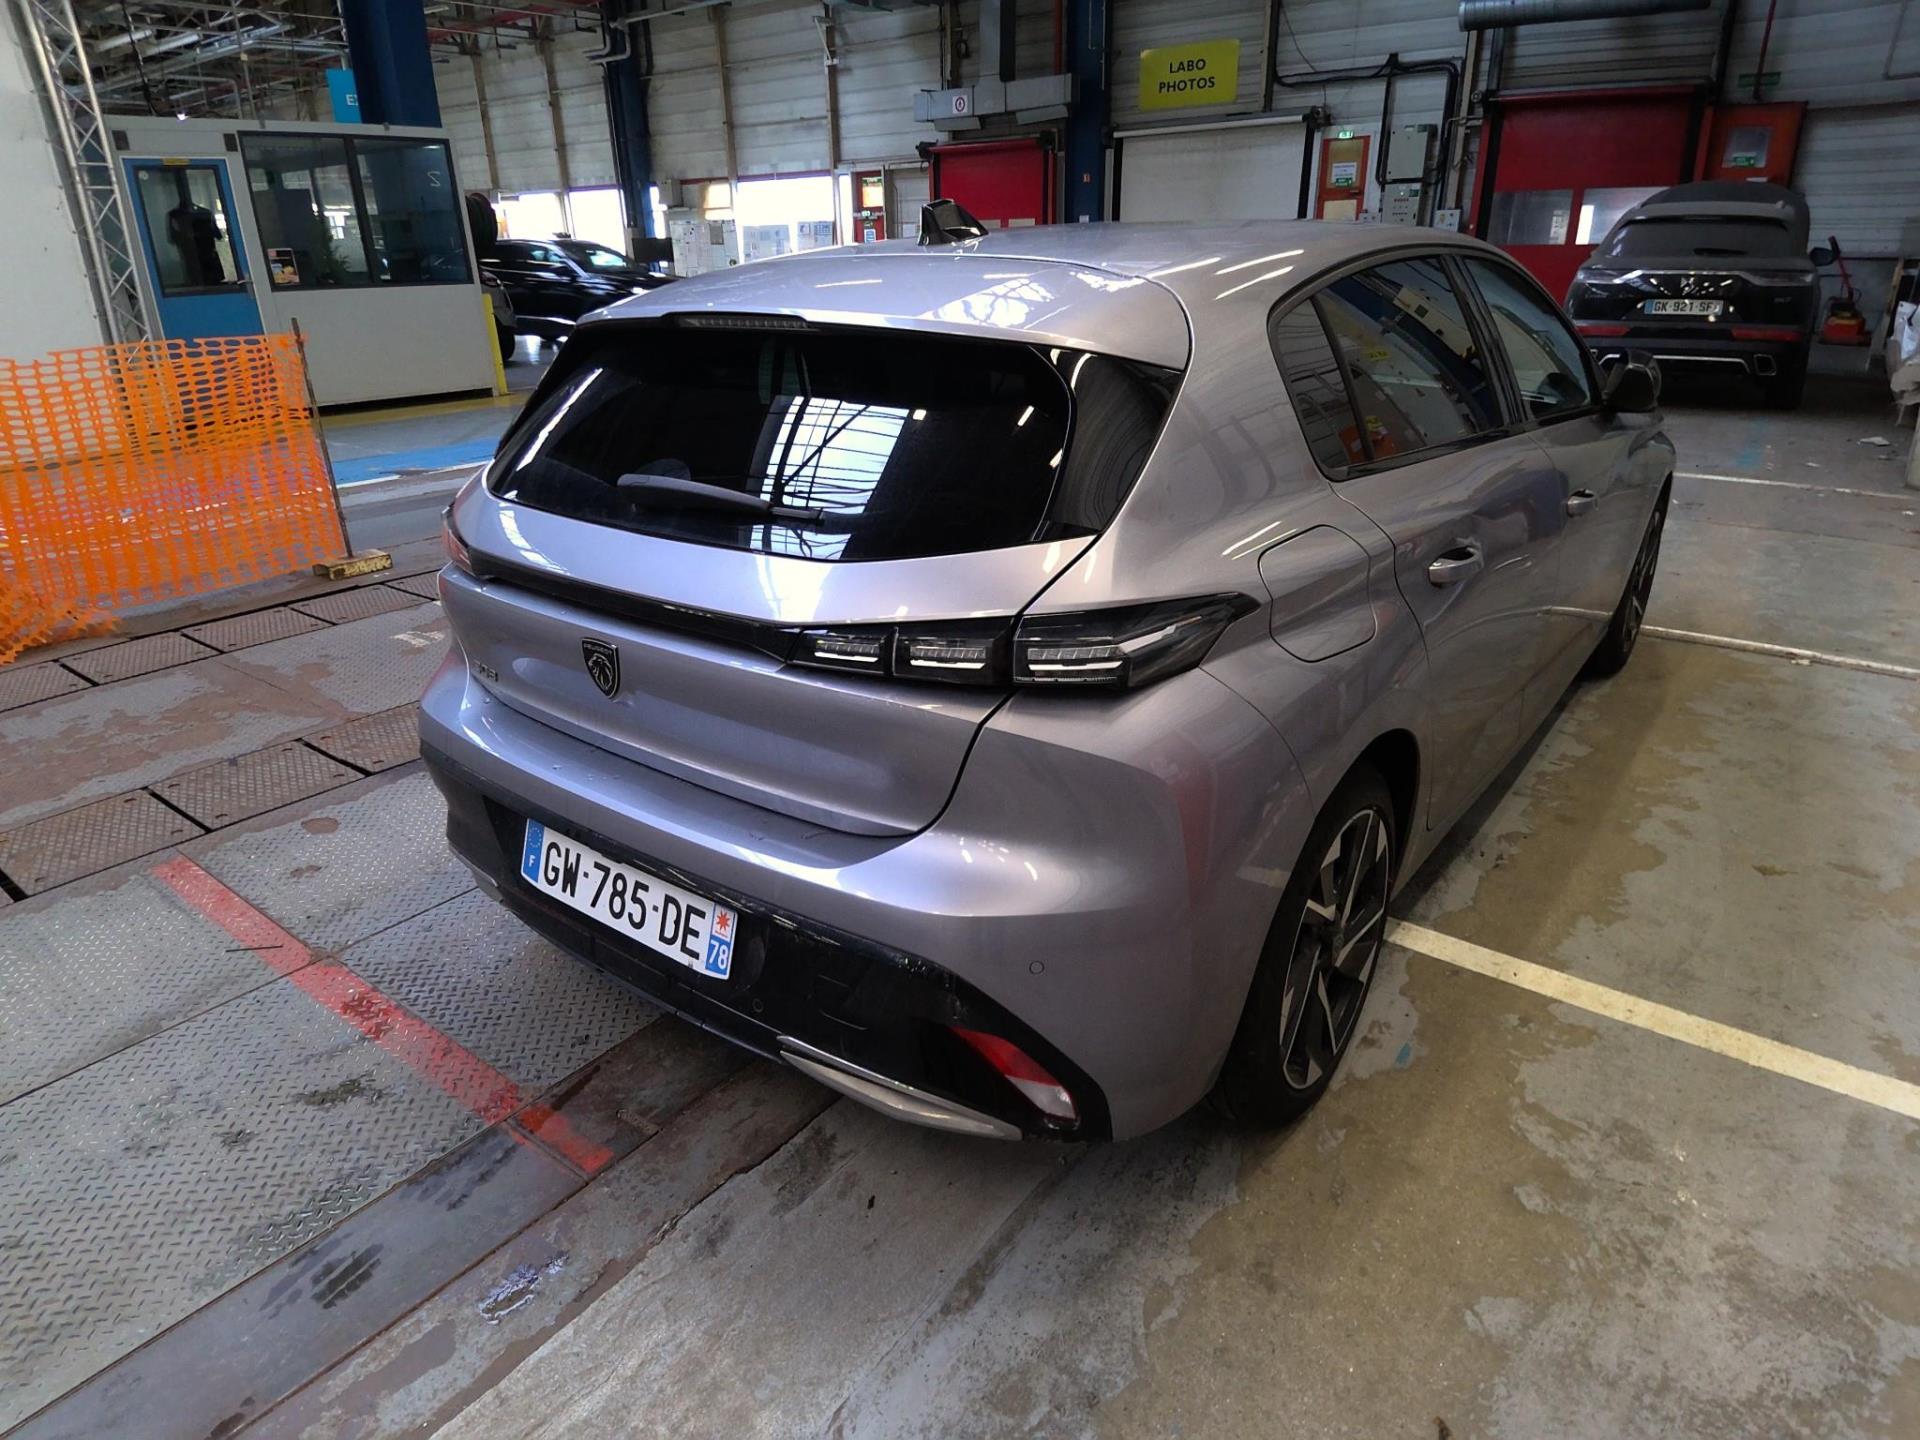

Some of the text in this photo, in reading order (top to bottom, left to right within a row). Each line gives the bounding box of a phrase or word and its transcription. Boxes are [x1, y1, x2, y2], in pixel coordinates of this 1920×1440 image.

[1169, 59, 1206, 74] LABO
[1158, 76, 1215, 94] PHOTOS
[528, 854, 535, 868] F
[543, 841, 706, 961] GW-785-DE
[708, 940, 729, 971] 78
